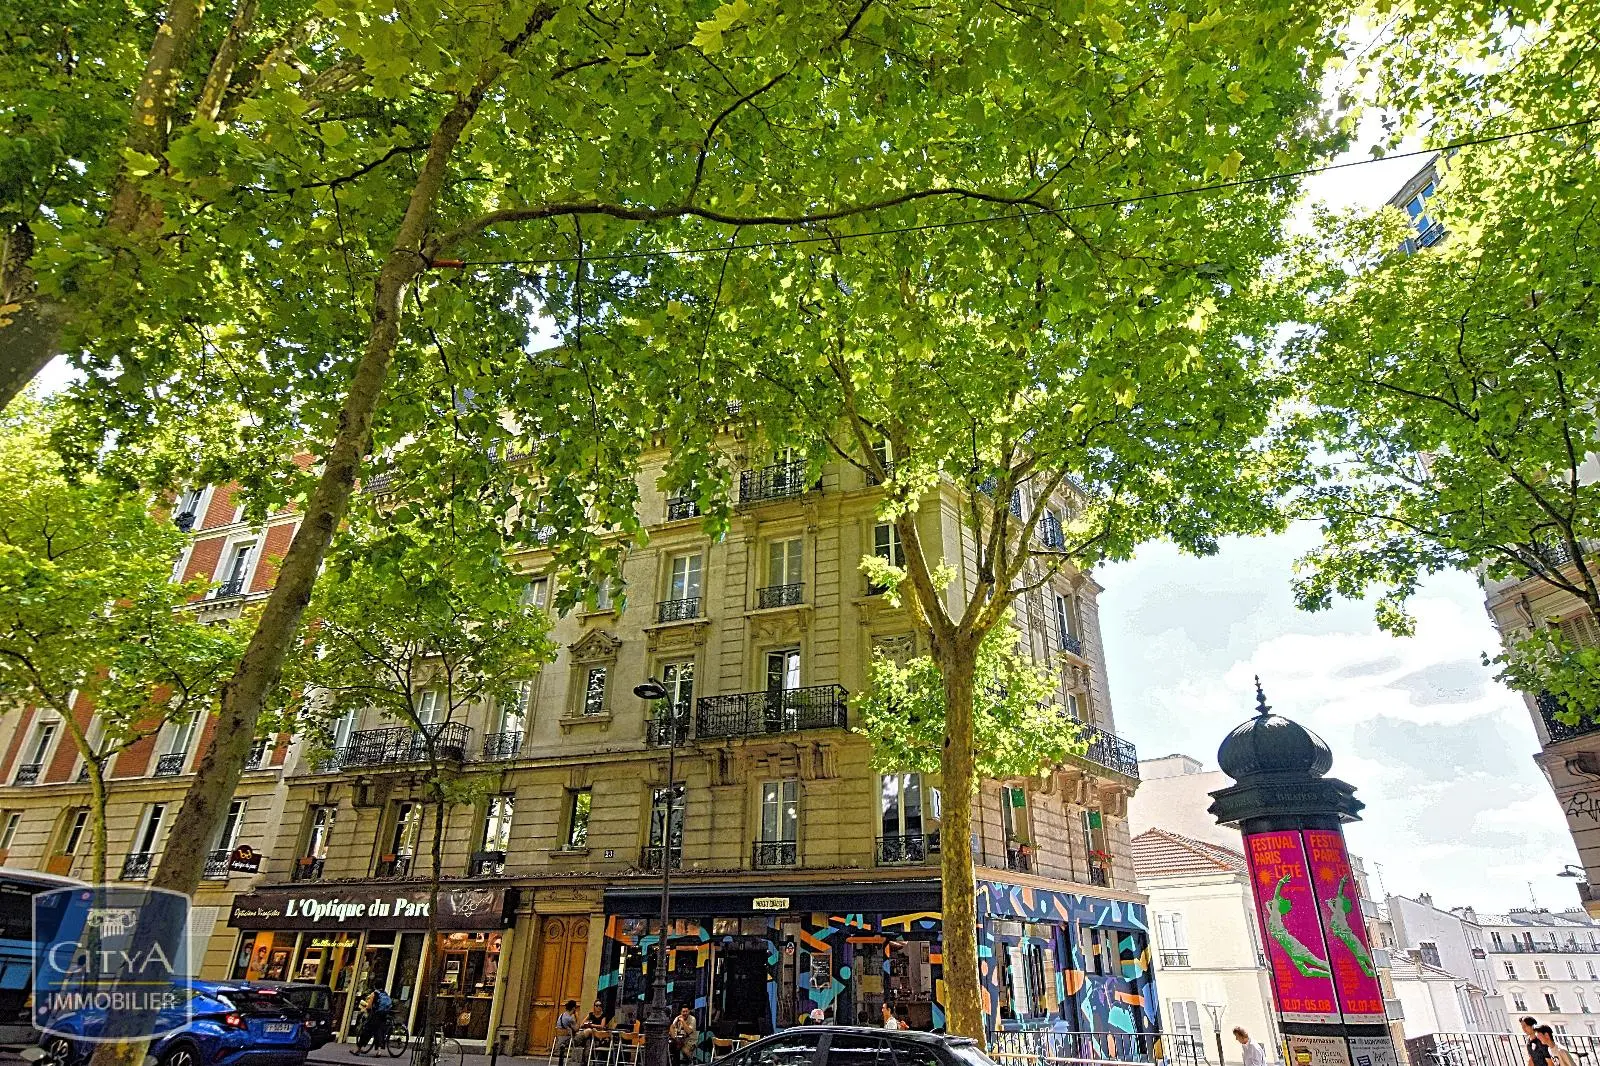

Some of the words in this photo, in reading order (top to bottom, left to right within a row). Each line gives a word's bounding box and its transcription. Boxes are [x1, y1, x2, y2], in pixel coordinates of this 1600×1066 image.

[1251, 836, 1296, 852] FESTIVAL
[1254, 850, 1281, 866] PARIS
[1313, 848, 1341, 863] PARIS
[1274, 861, 1303, 879] L'ÉTÉ
[285, 898, 366, 922] L'Optique
[368, 898, 391, 917] du
[392, 898, 430, 917] Parc
